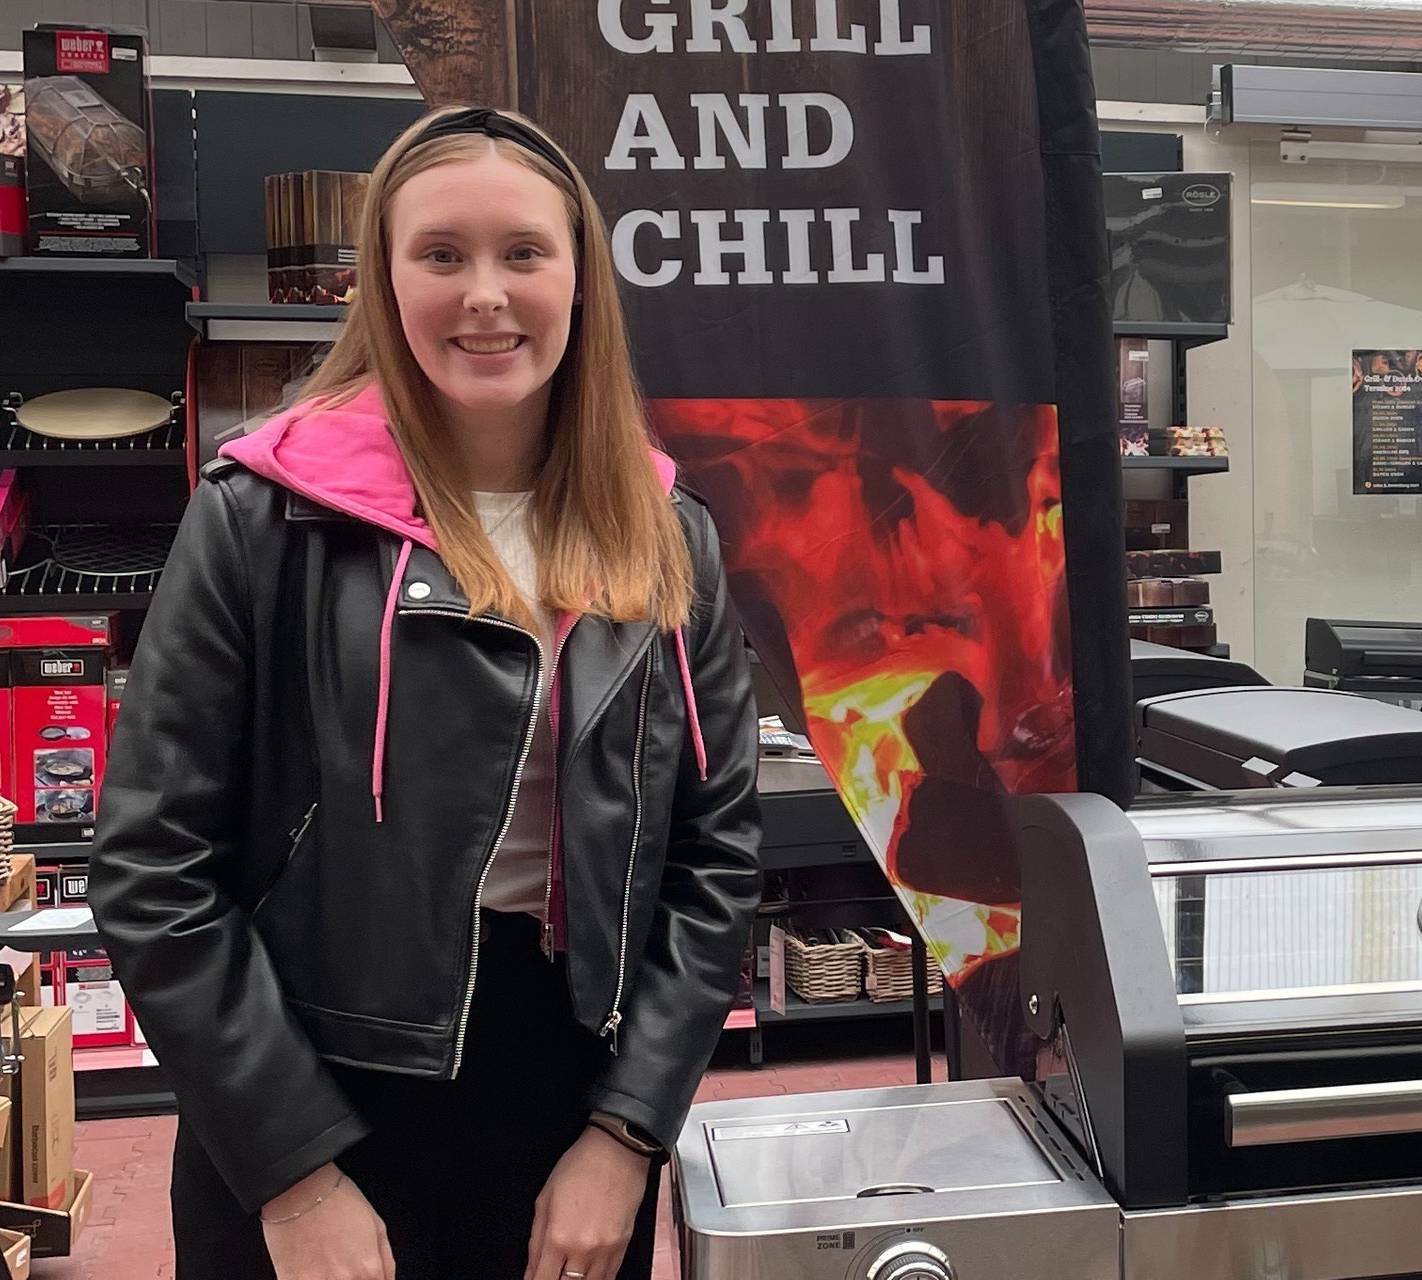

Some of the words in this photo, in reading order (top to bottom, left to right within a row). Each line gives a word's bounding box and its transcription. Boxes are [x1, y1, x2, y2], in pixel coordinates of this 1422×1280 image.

[61, 35, 94, 52] weber
[597, 0, 932, 55] GRILL
[604, 92, 855, 170] AND
[611, 208, 945, 287] CHILL
[44, 660, 73, 674] weber
[816, 1242, 840, 1250] ZONE
